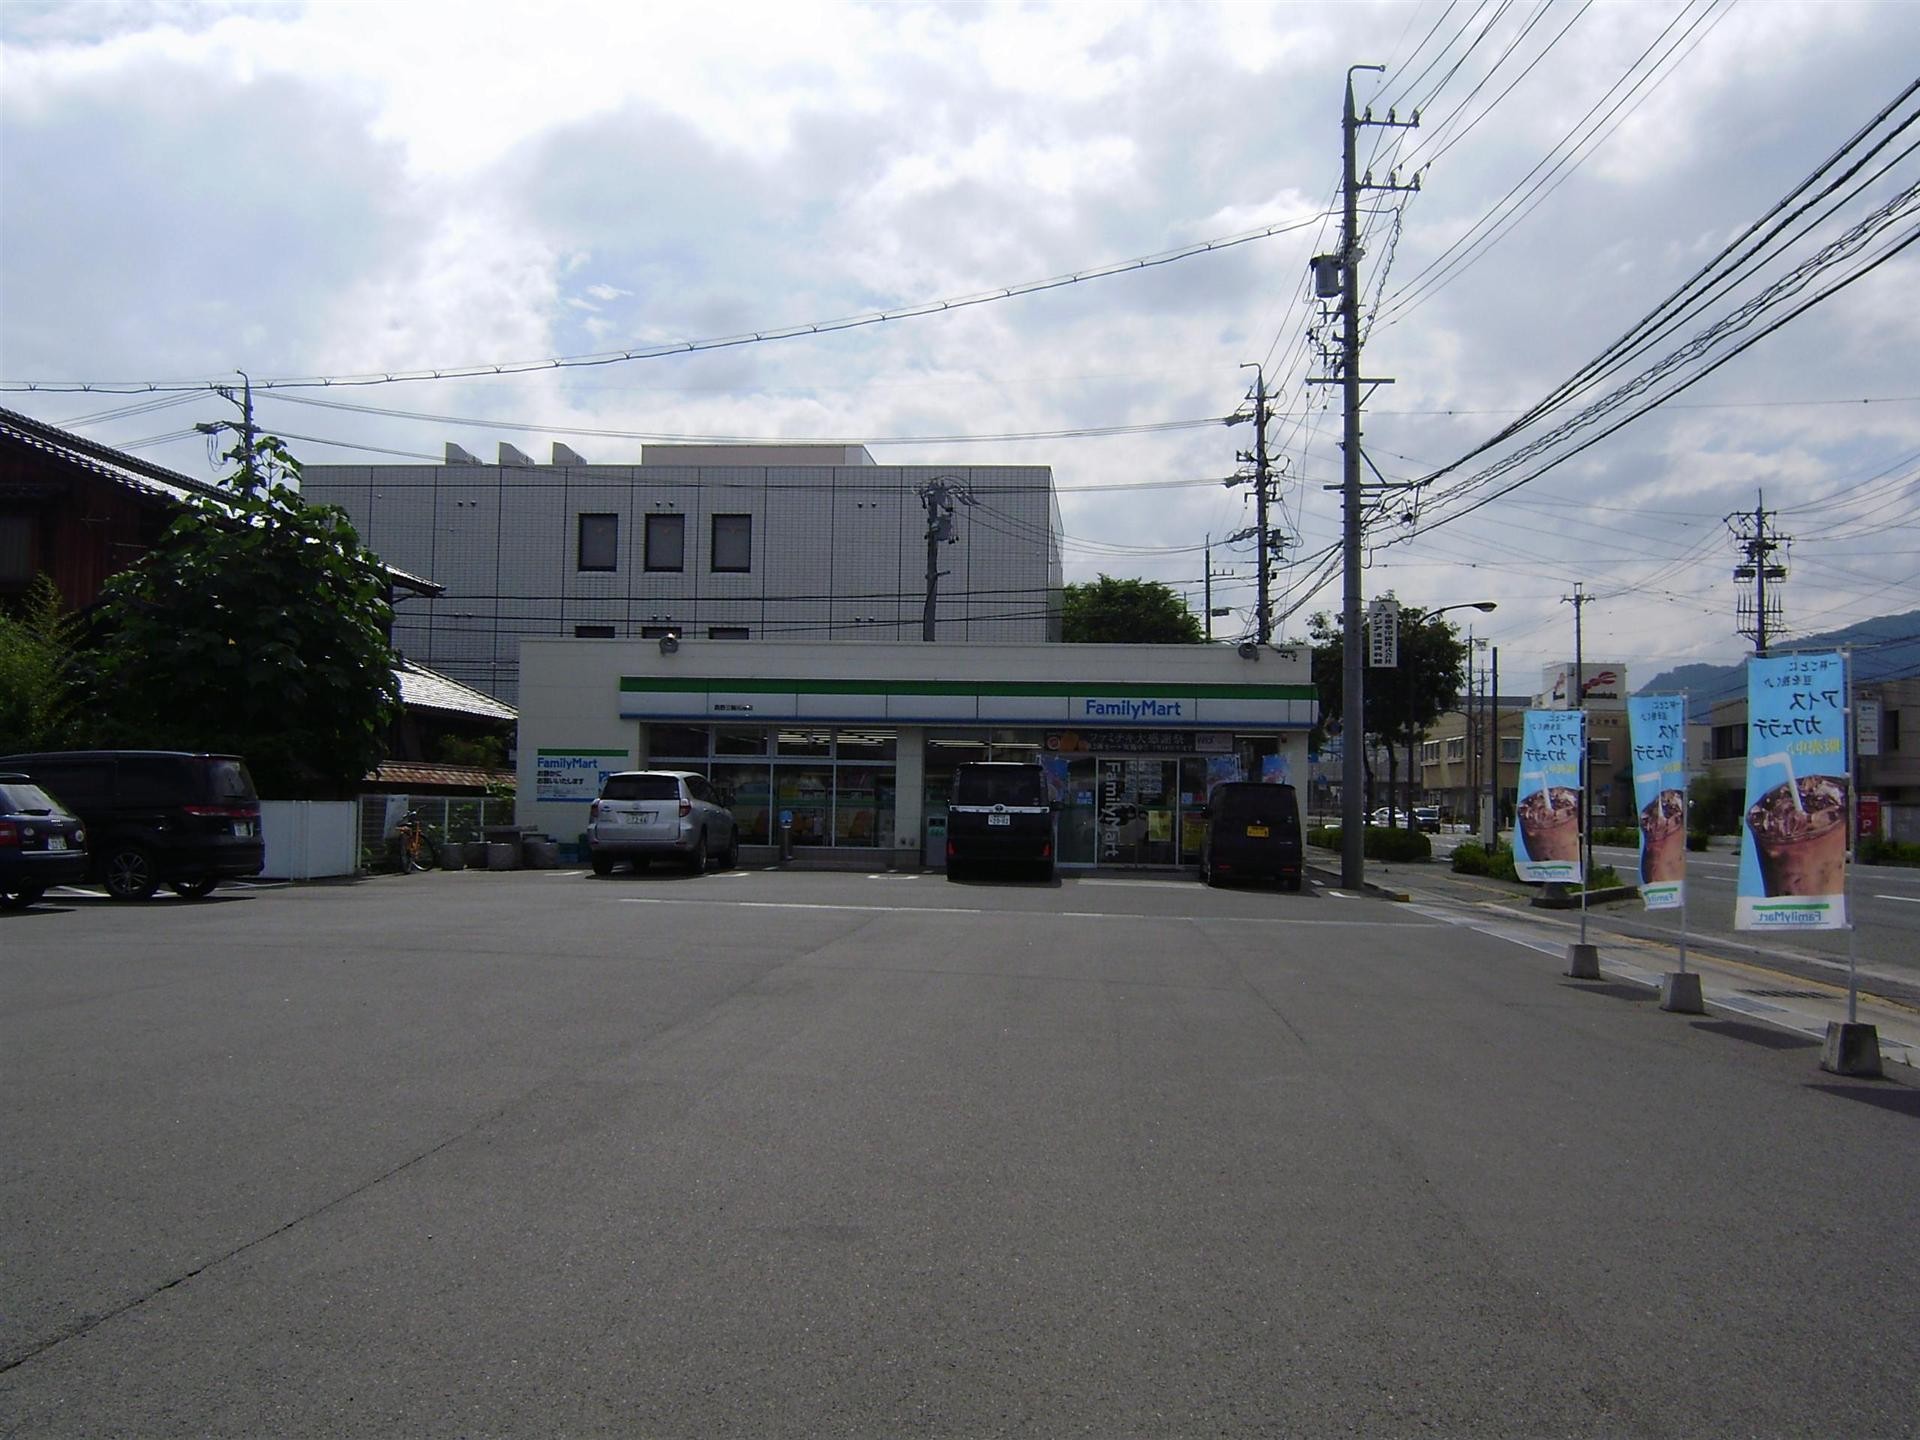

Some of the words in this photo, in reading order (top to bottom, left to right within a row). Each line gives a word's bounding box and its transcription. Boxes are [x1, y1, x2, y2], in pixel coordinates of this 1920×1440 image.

[1085, 699, 1182, 721] FamilyMart
[537, 757, 598, 770] FamilyMart
[1101, 762, 1121, 857] FamilyMart
